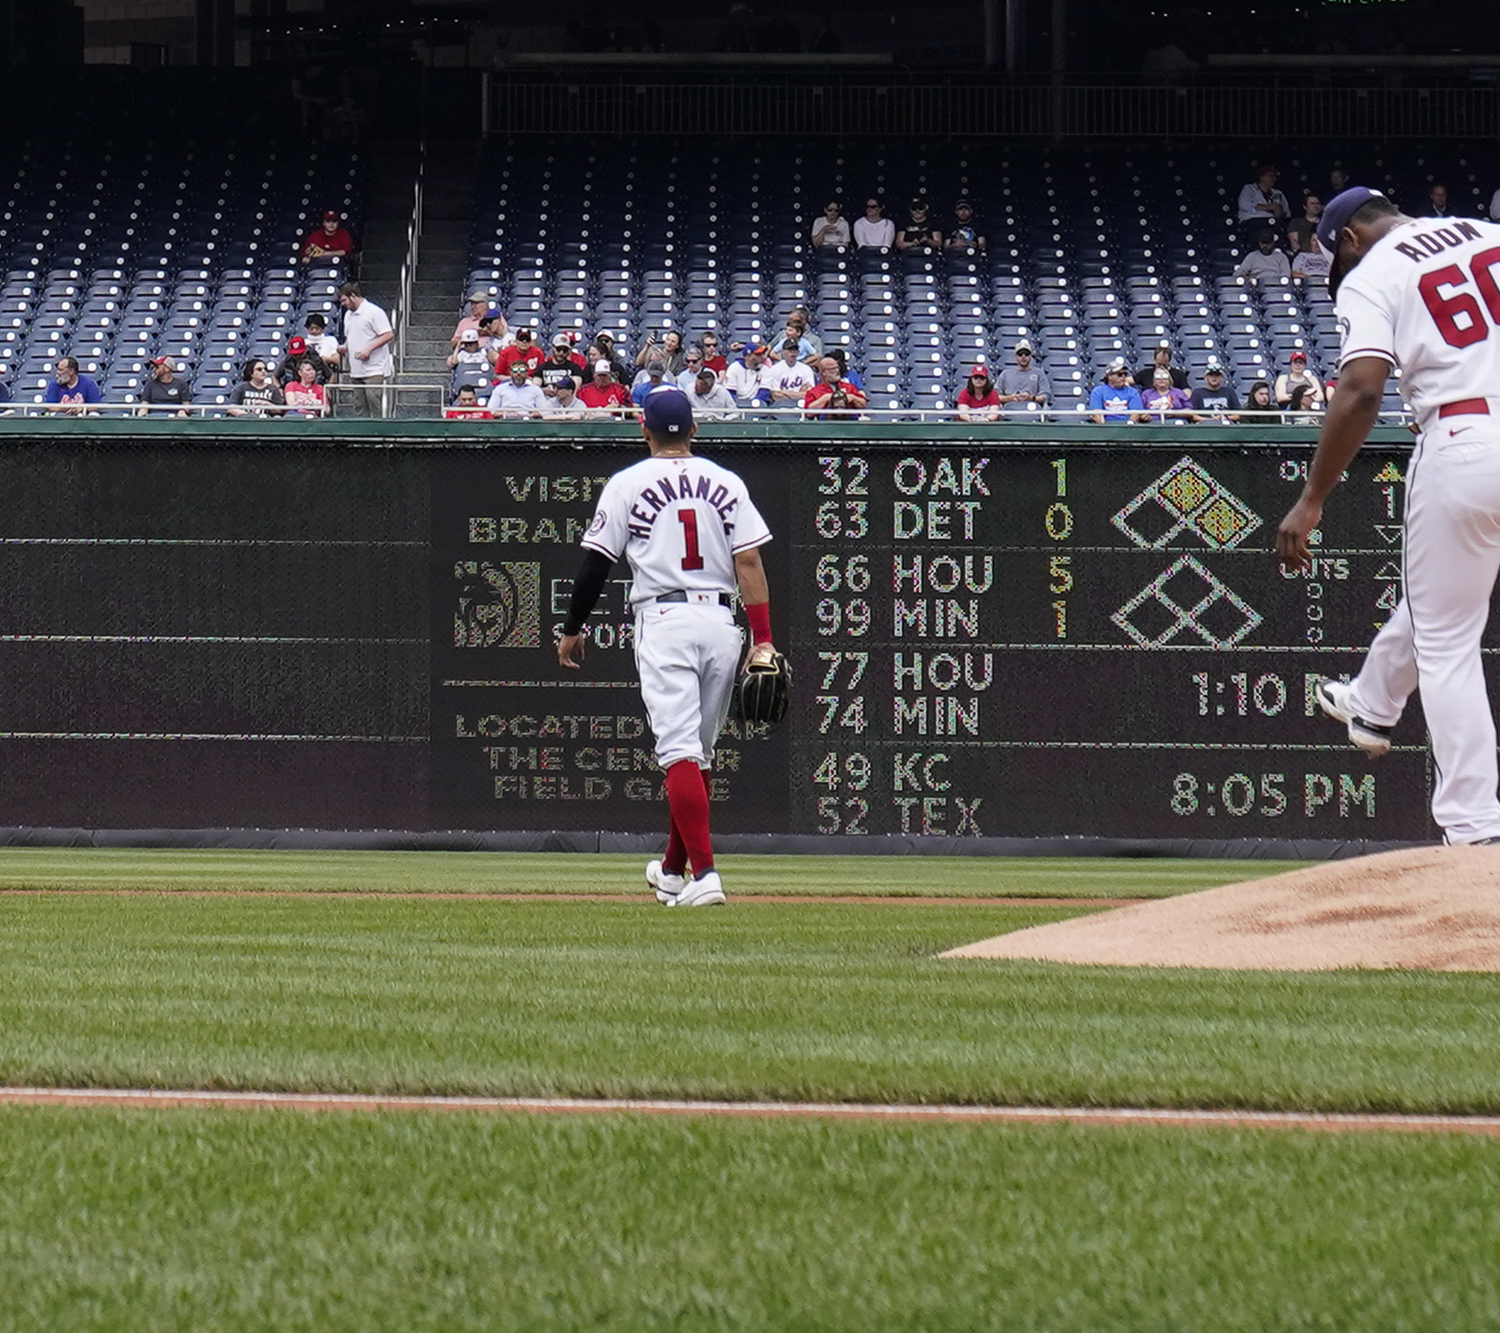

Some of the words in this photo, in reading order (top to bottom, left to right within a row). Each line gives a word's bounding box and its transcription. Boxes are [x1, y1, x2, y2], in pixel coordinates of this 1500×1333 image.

[1394, 221, 1485, 263] ADON
[816, 457, 870, 496] 32
[893, 457, 992, 497] OAK
[1050, 458, 1068, 497] 1
[677, 508, 705, 571] 1
[815, 501, 869, 539] 63
[893, 501, 982, 541] DET
[1045, 502, 1074, 541] 0
[815, 554, 871, 593] 66
[892, 554, 994, 594] HOU
[1048, 555, 1074, 594] 5
[815, 598, 871, 637] 99
[892, 598, 980, 638] MIN
[816, 652, 871, 690] 77
[892, 652, 994, 691] HOU
[1191, 672, 1288, 717] 1:10
[455, 714, 645, 740] LOCATED
[815, 696, 870, 734] 74
[892, 696, 980, 735] MIN
[482, 746, 565, 771] THE
[574, 746, 742, 773] CENR
[813, 752, 871, 791] 49
[892, 752, 952, 792] KC
[494, 775, 612, 801] FIELD
[1170, 772, 1288, 818] 8:05
[1303, 773, 1378, 819] PM
[816, 796, 870, 835] 52
[892, 796, 982, 837] TEX
